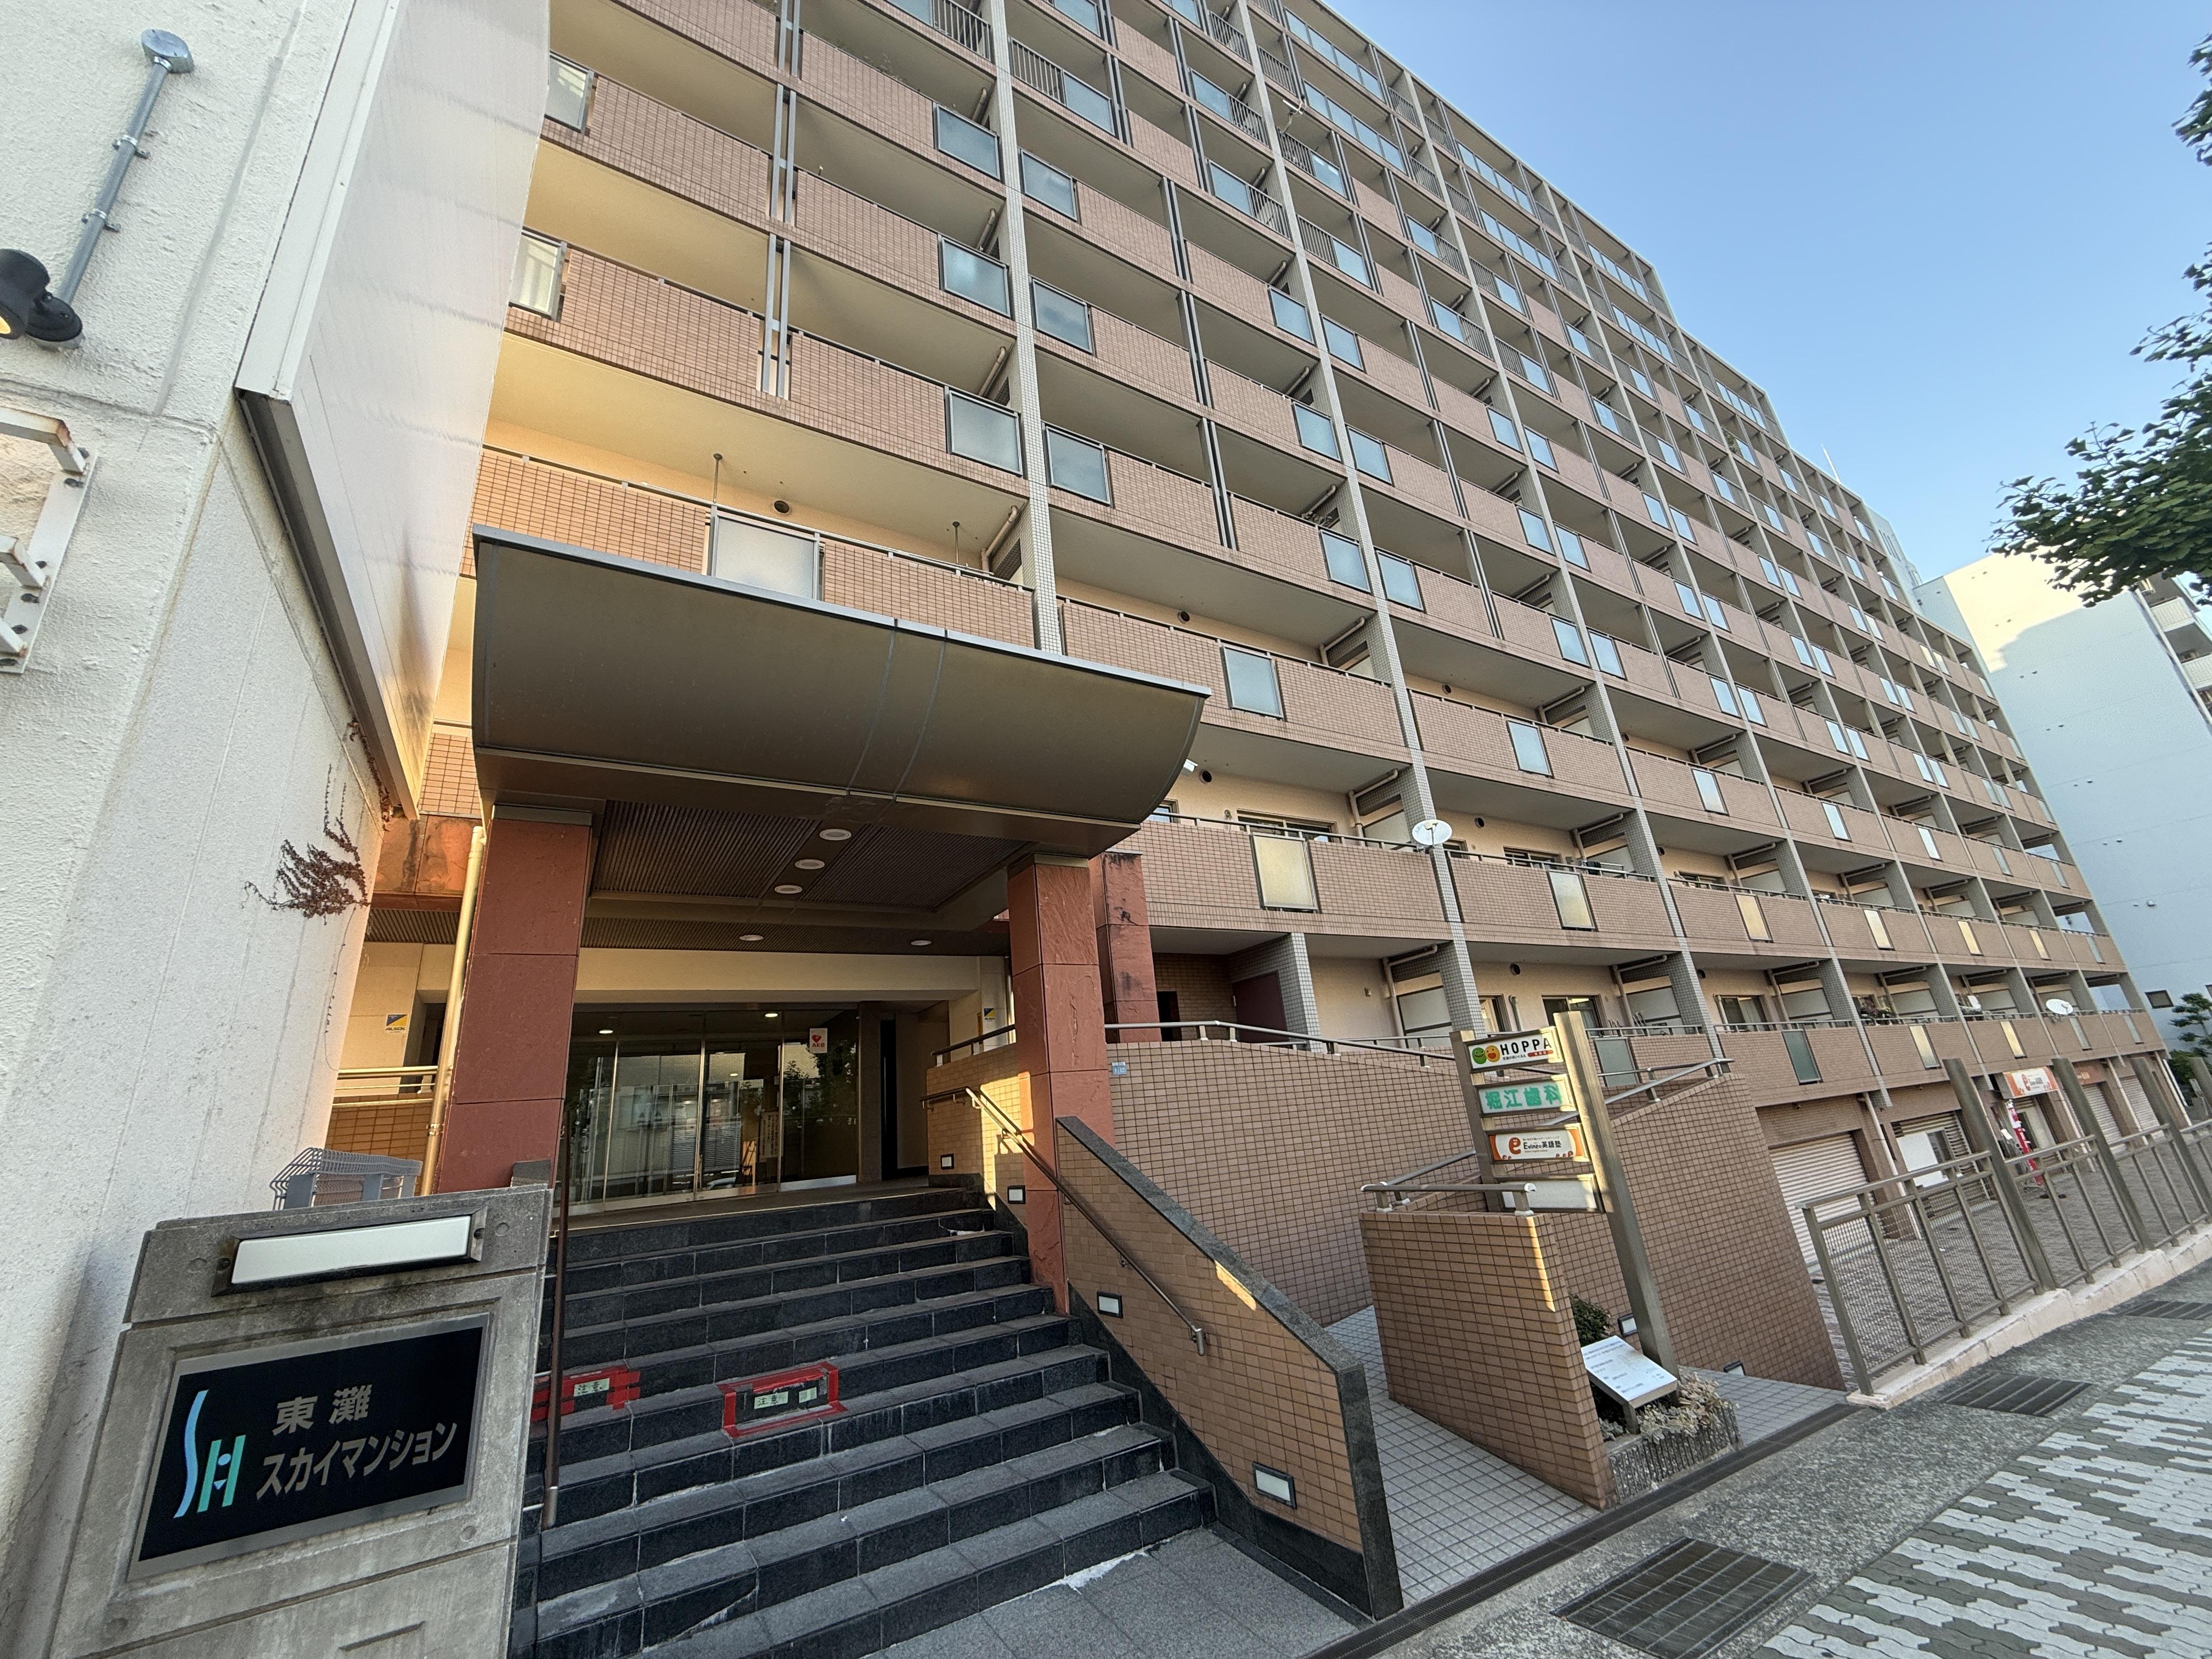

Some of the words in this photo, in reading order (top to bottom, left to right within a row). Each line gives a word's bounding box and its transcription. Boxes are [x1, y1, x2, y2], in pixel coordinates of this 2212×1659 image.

[1500, 1037, 1552, 1055] HOPPA
[578, 1381, 602, 1395] 注意
[272, 1384, 373, 1436] 東灘
[758, 1395, 778, 1407] 注意
[256, 1422, 457, 1500] スカイマンション
